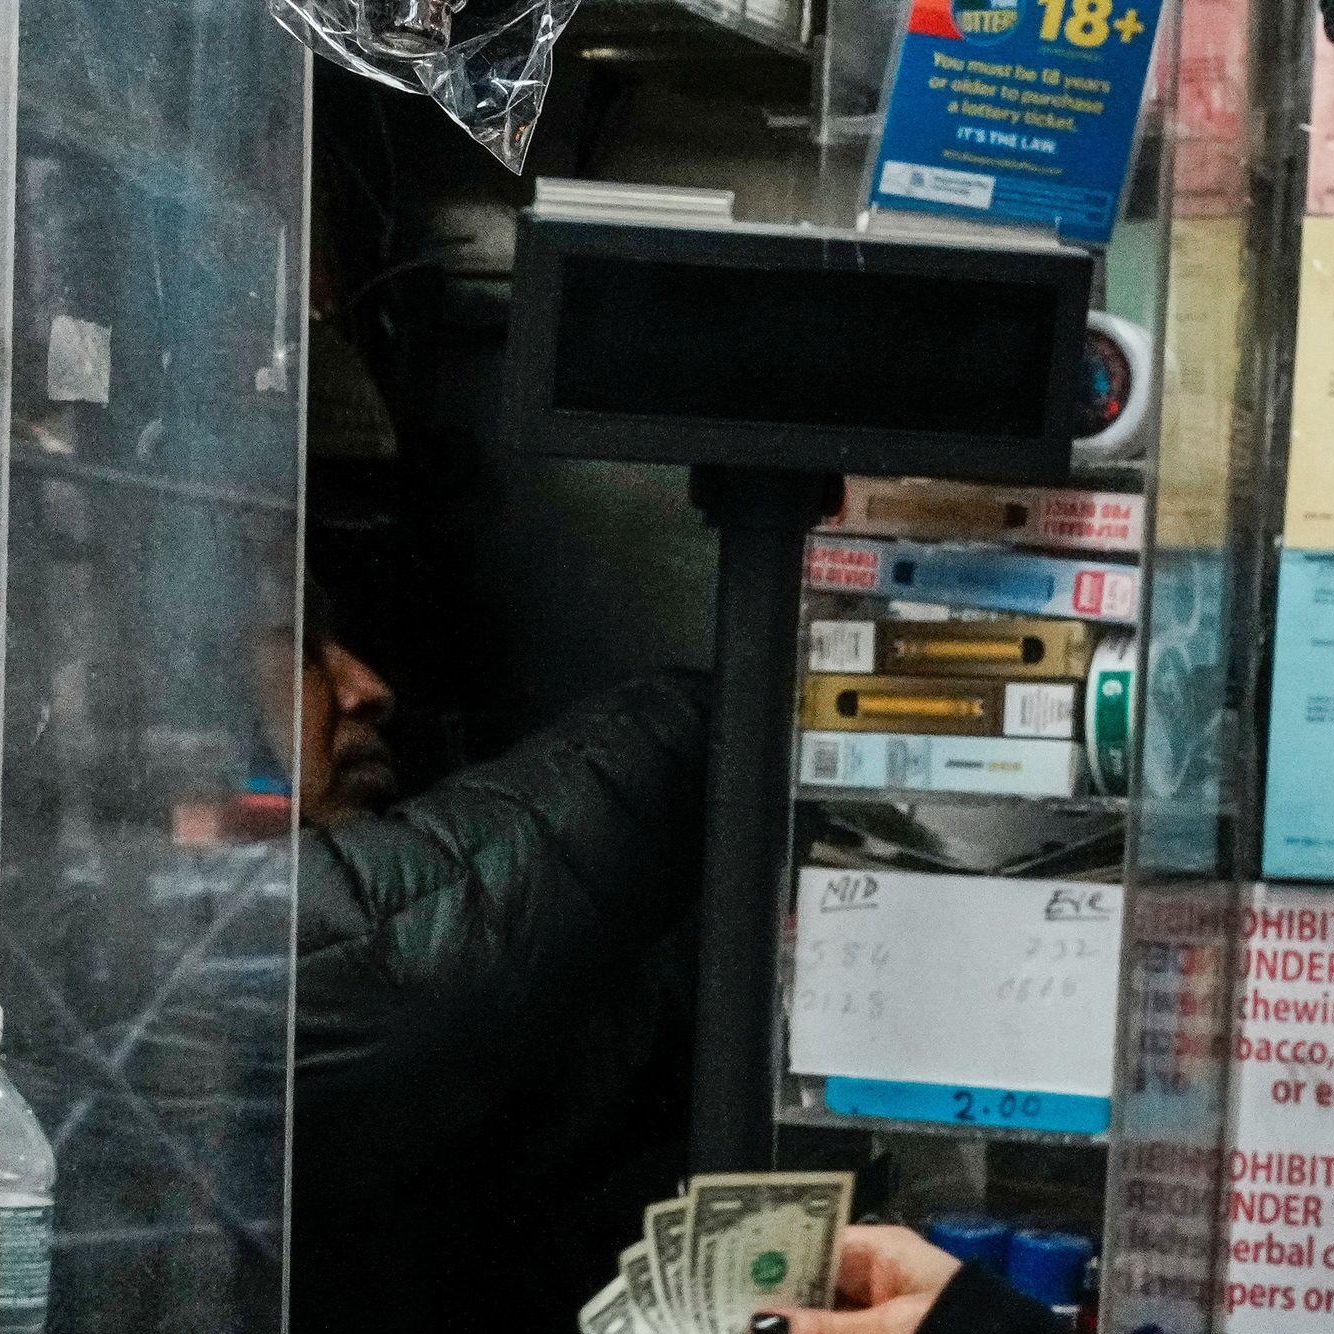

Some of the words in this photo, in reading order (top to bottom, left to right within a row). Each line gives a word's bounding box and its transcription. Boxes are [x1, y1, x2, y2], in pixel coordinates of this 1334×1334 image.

[1038, 0, 1145, 47] 18+
[990, 129, 1017, 148] THE
[822, 876, 878, 903] MID
[954, 1089, 1042, 1121] 2.00
[1272, 1079, 1306, 1106] or
[1304, 1289, 1334, 1314] or
